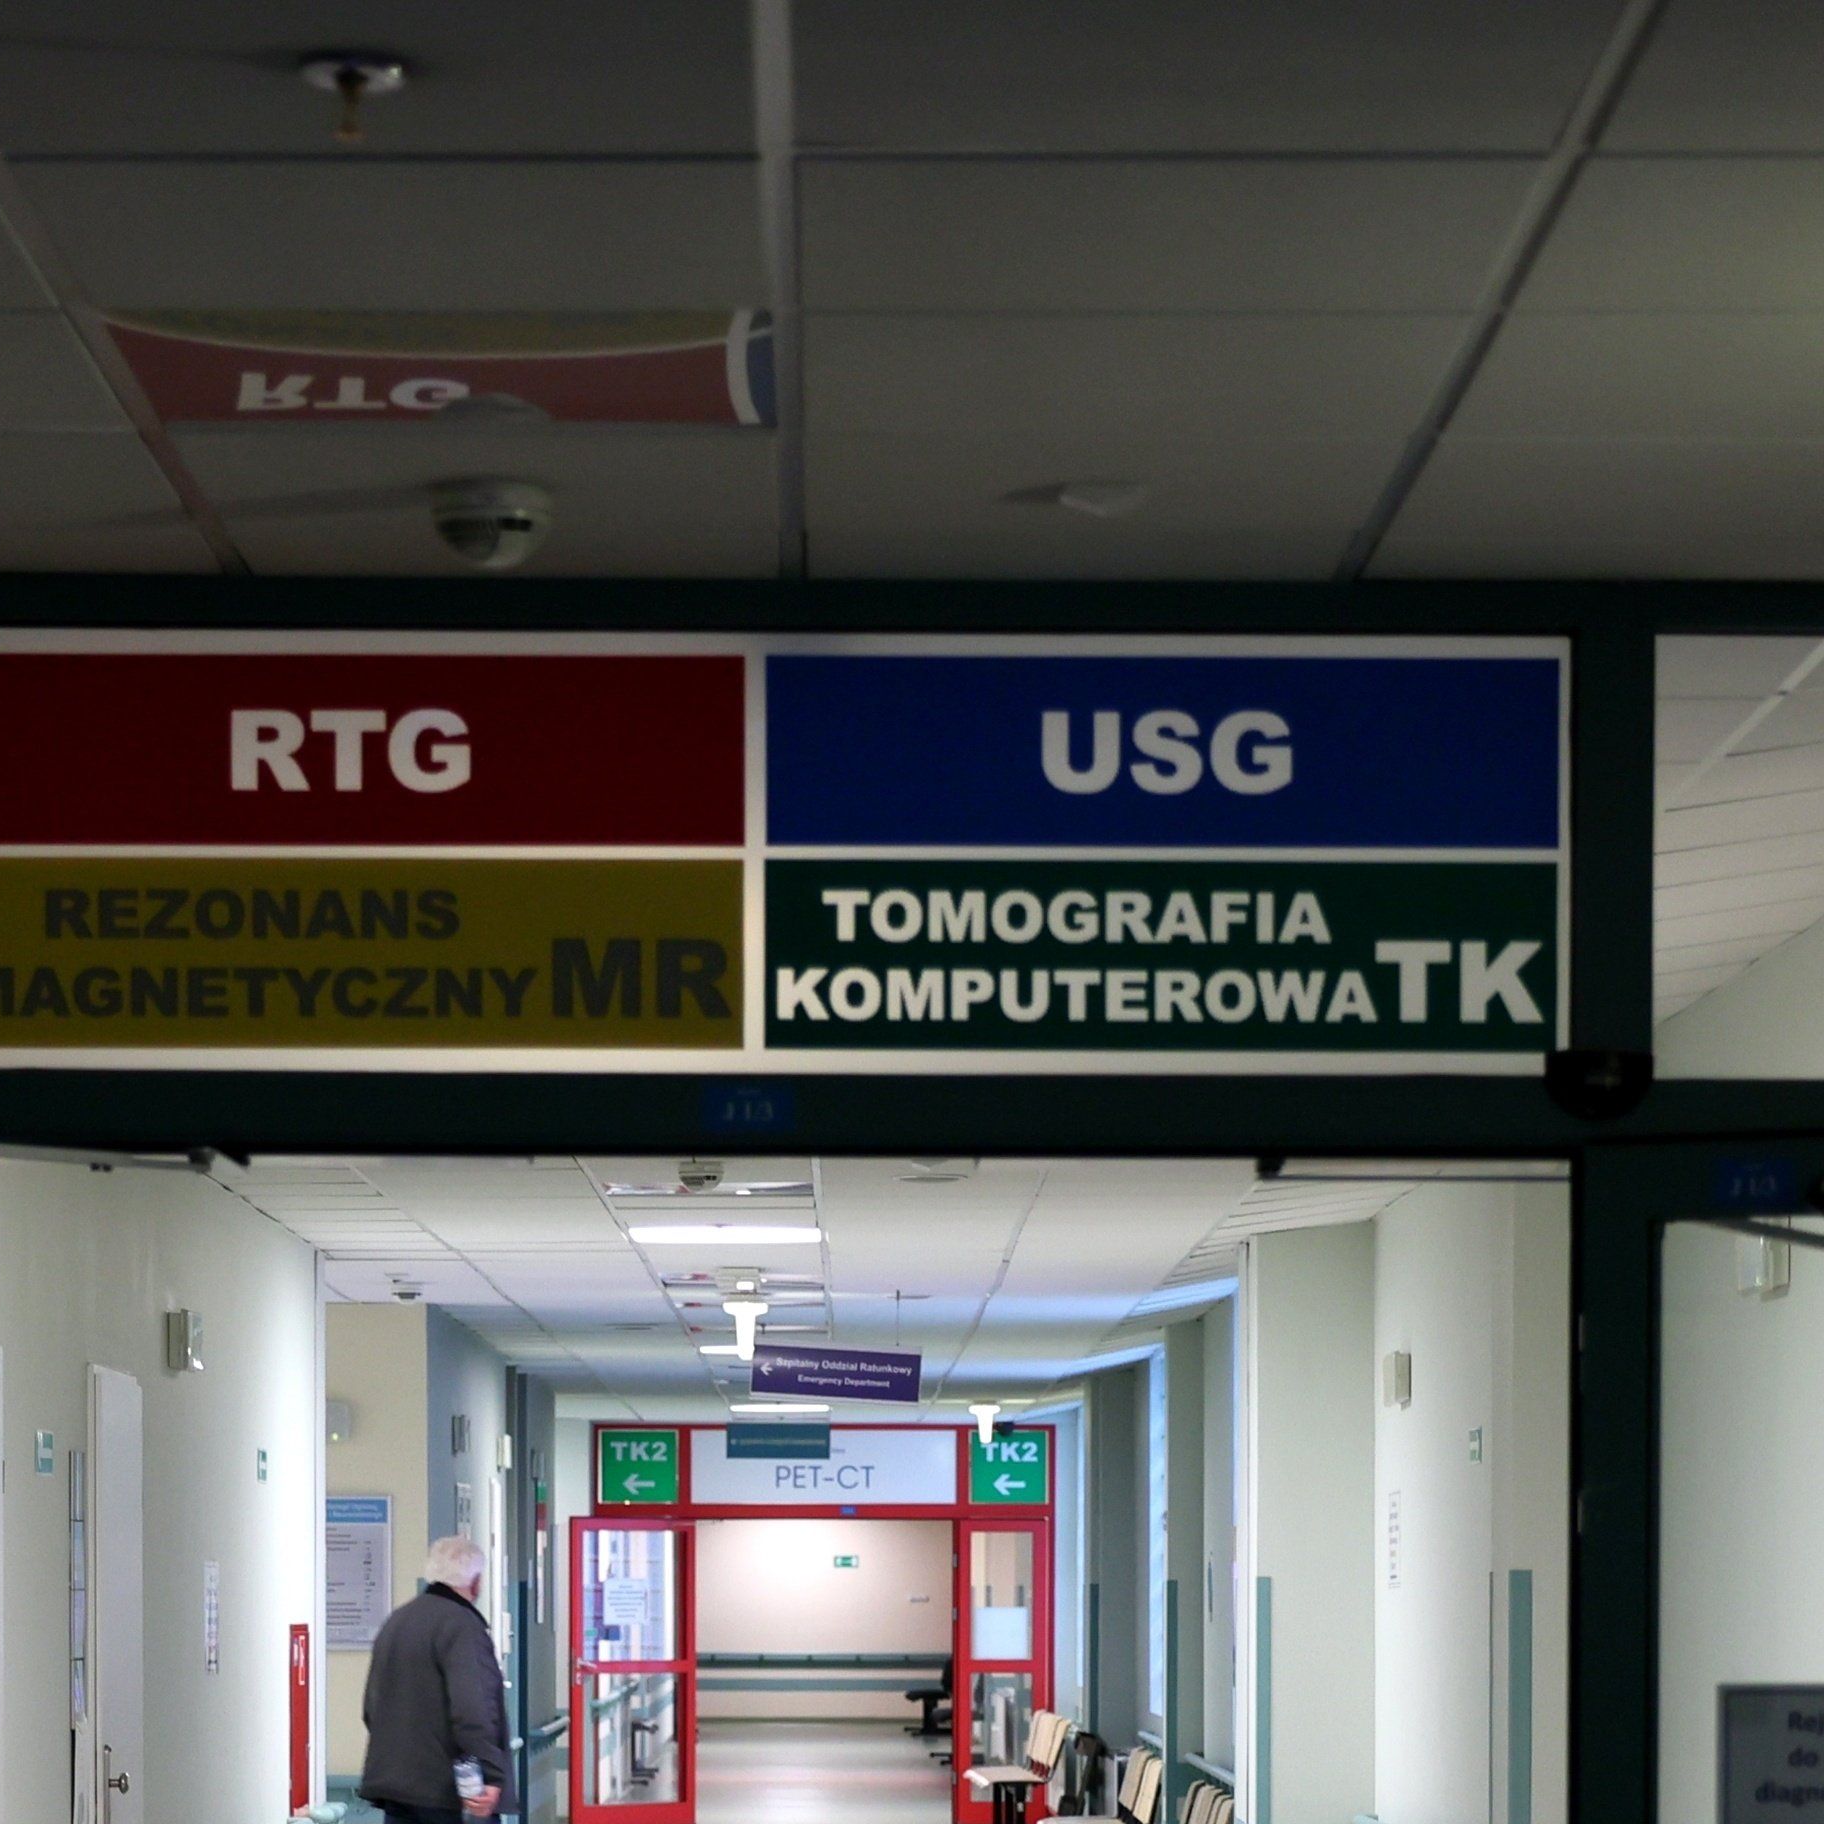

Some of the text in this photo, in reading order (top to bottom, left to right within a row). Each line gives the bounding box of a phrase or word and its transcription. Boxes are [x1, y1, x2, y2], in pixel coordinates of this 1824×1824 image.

[231, 709, 472, 793] RTG
[1042, 710, 1294, 795] USG
[42, 887, 461, 941] REZONANS
[821, 888, 1330, 945] TOMOGRAFIA
[550, 935, 734, 1020] MR
[776, 965, 1376, 1023] KOMPUTEROWA
[1375, 941, 1543, 1023] TK
[776, 1357, 819, 1370] Szpitalny
[859, 1362, 913, 1376] Ratunkowy
[797, 1374, 891, 1389] Emergency Department
[610, 1441, 668, 1461] TK2
[775, 1466, 875, 1489] PET-CT
[981, 1441, 1038, 1463] TK2
[1787, 1747, 1819, 1768] do
